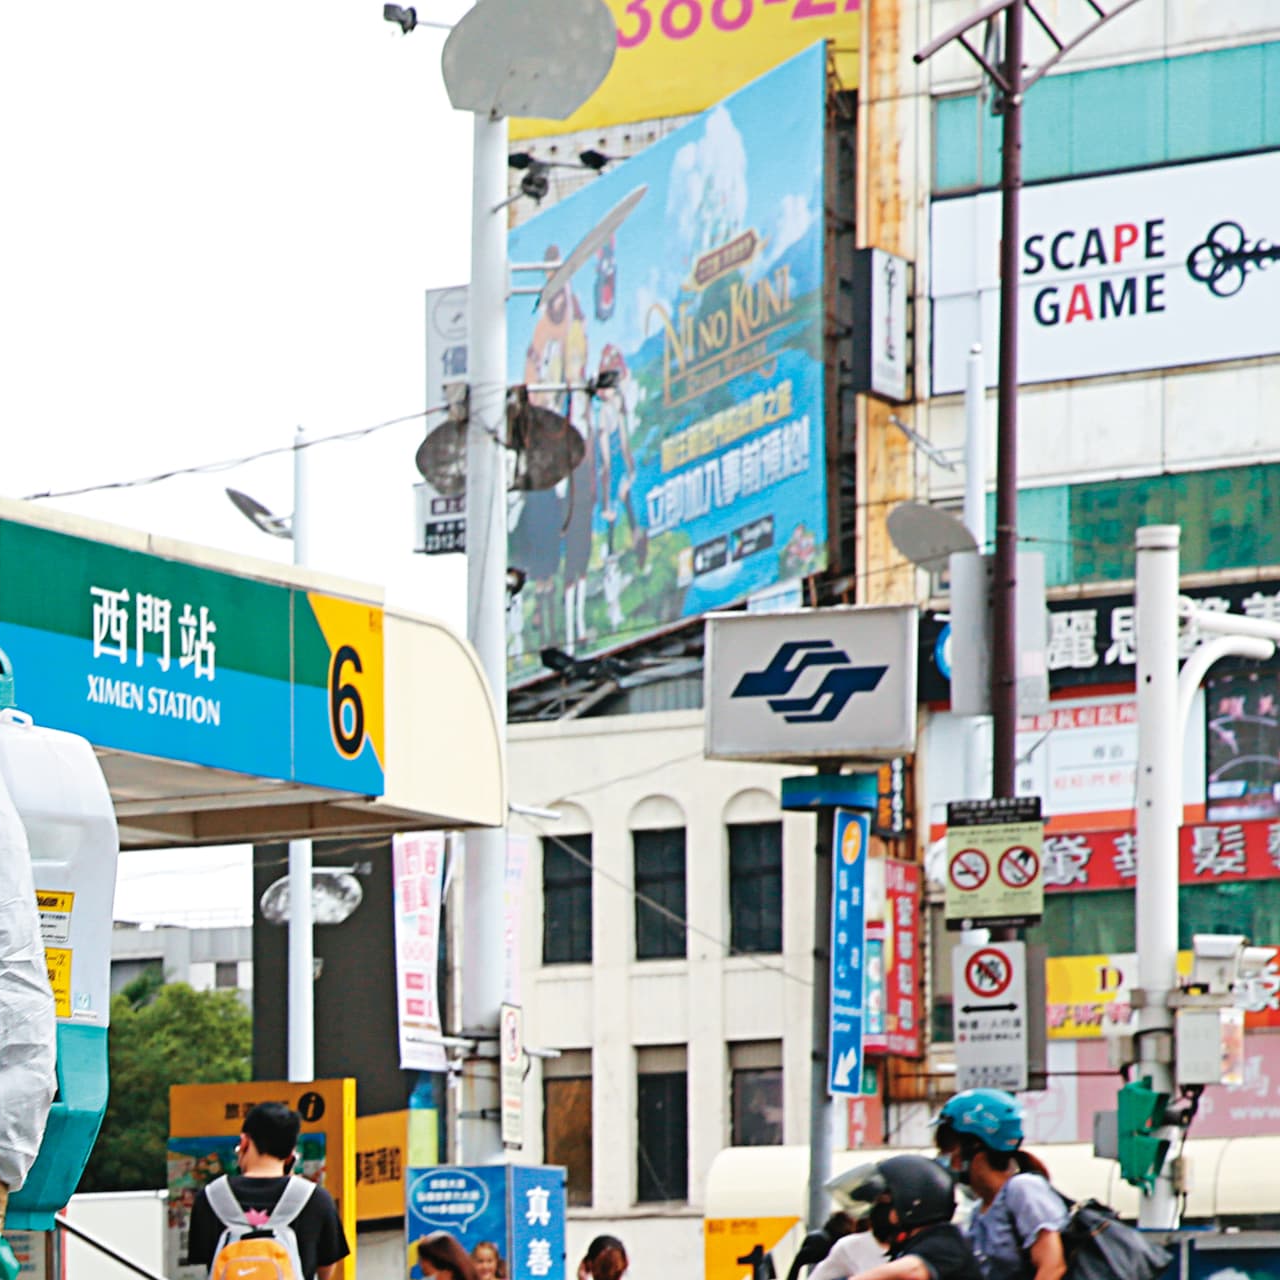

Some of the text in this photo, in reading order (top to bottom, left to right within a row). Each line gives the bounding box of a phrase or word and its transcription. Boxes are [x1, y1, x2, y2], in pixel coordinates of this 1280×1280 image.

[1034, 274, 1165, 327] GAME
[90, 586, 217, 681] 西門站
[87, 674, 221, 727] XIMEN STATION
[331, 645, 364, 754] 6
